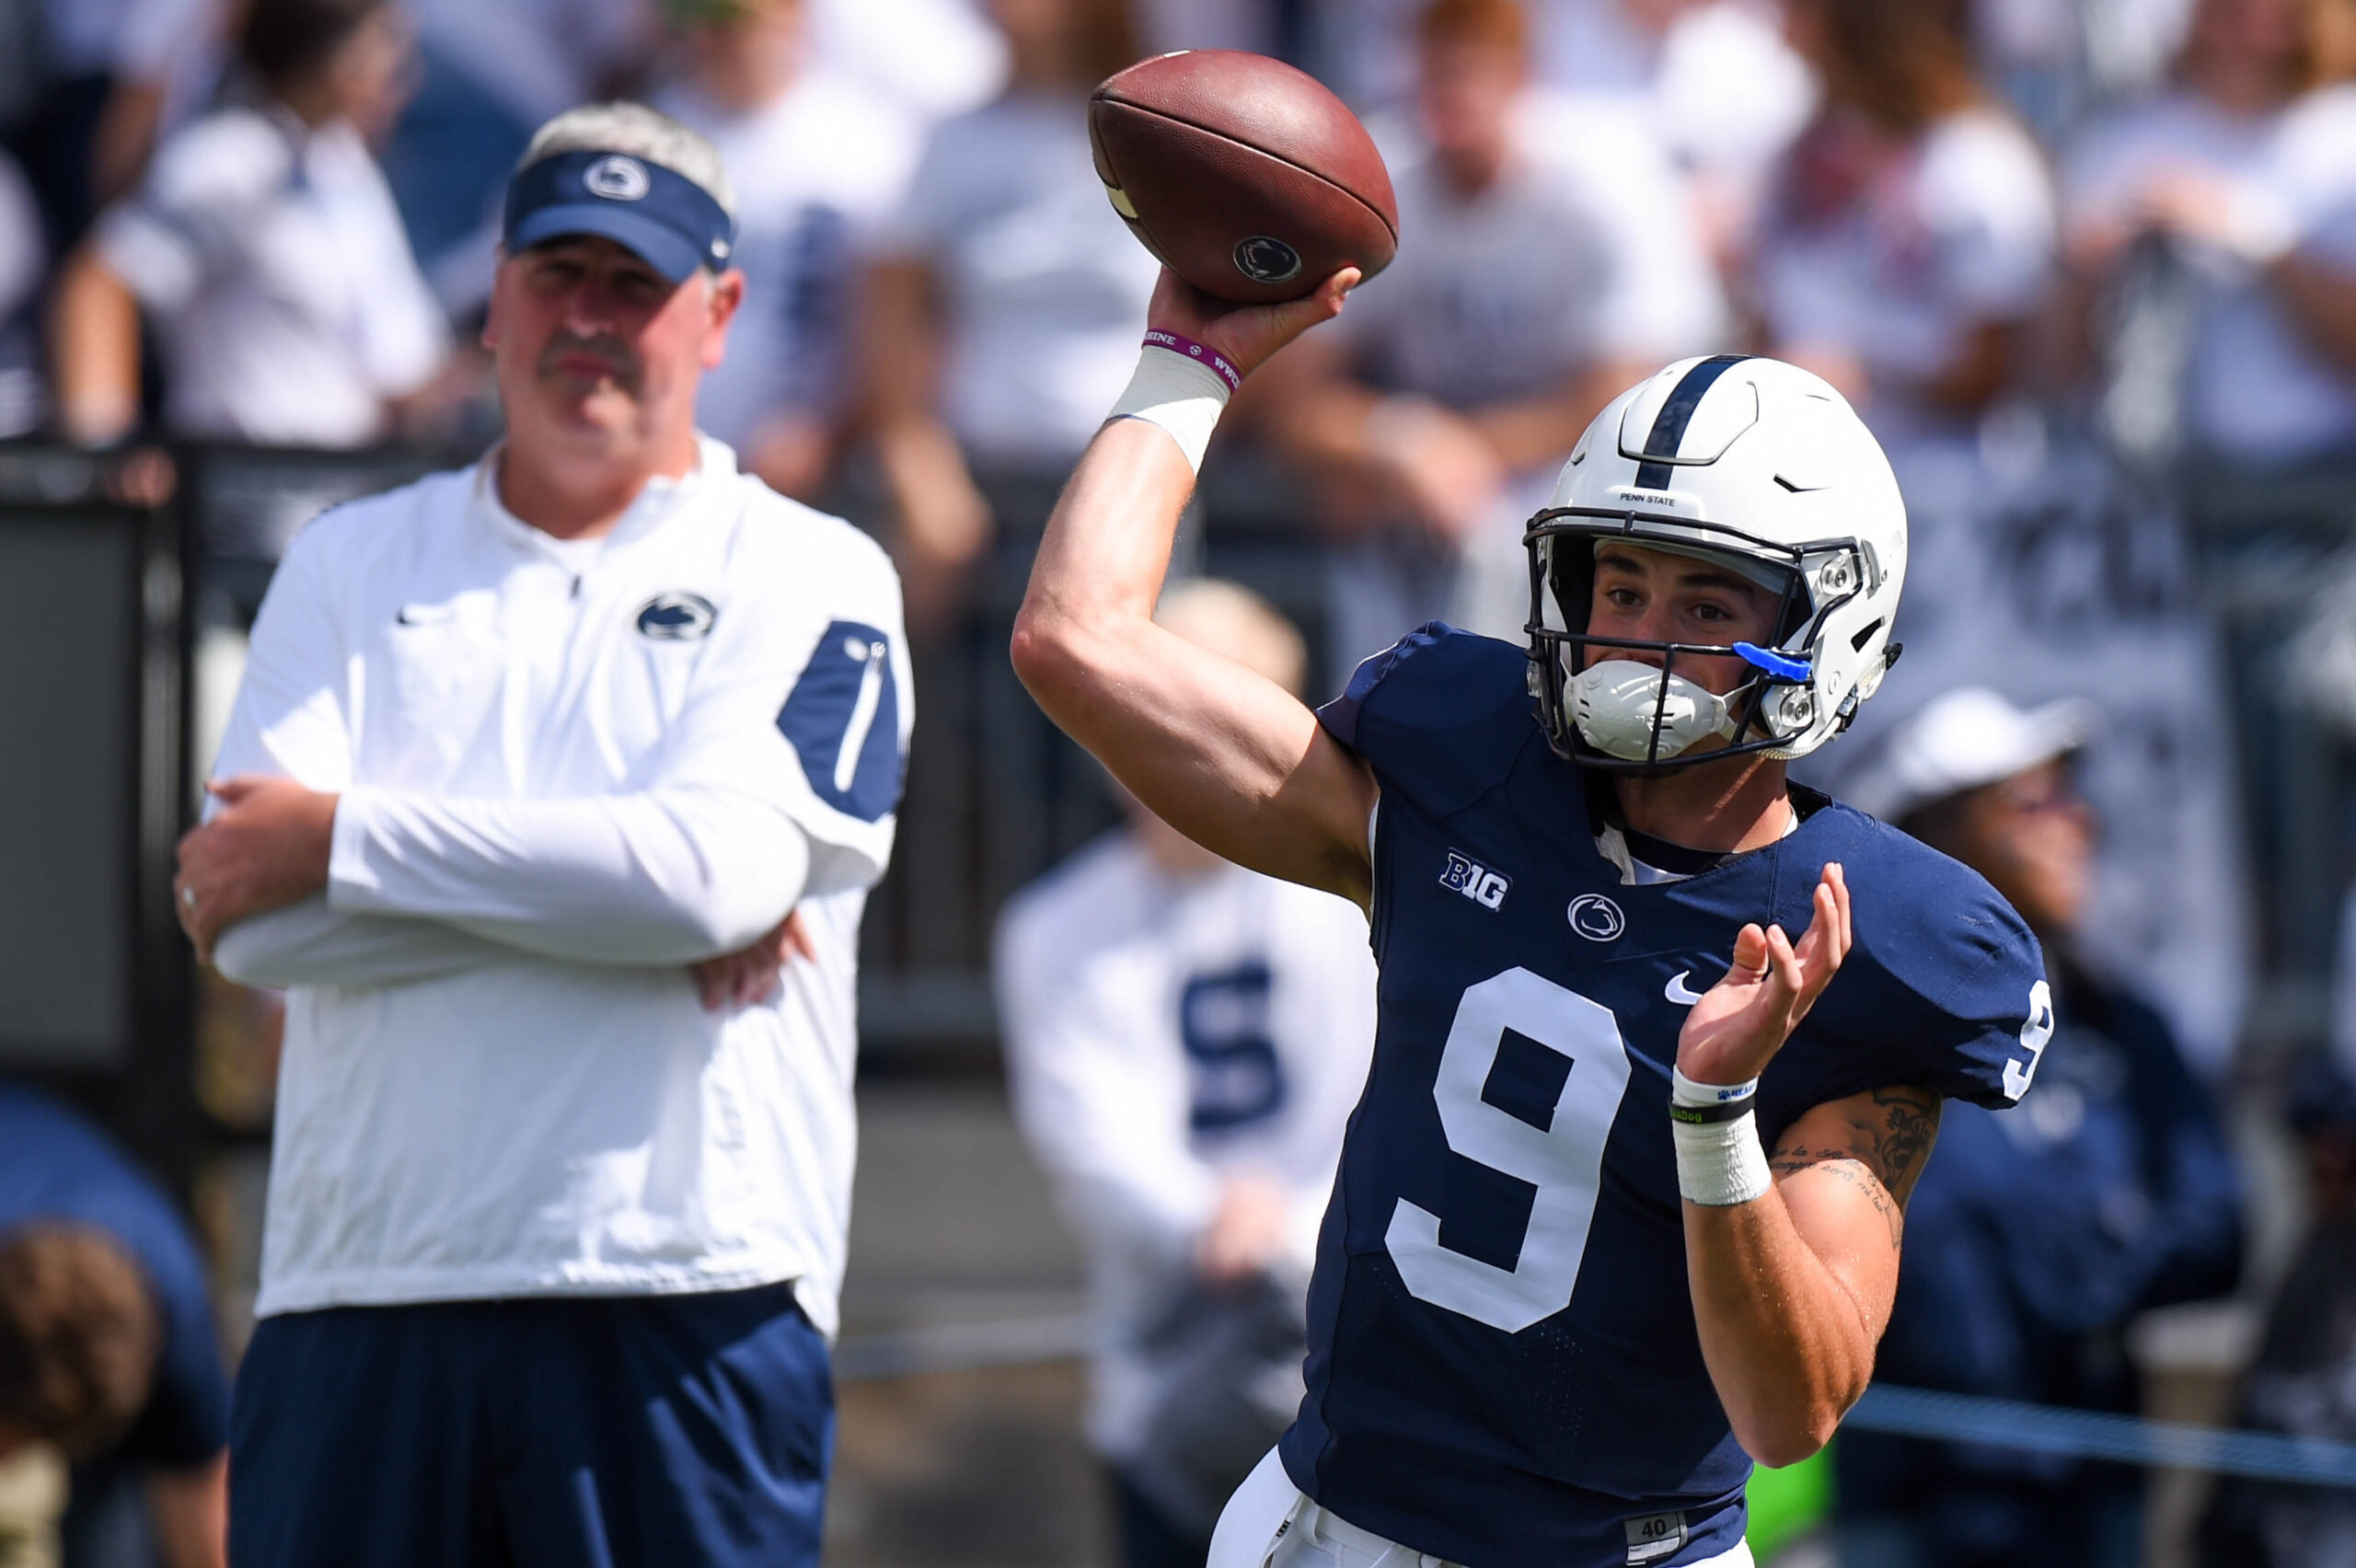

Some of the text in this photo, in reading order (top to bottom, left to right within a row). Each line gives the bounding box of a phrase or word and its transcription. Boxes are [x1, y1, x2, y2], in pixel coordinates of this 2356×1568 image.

[1620, 492, 1676, 507] PENN STATE
[1181, 959, 1287, 1134] S
[2002, 979, 2054, 1101] 9
[1384, 965, 1632, 1334] 9
[1642, 1519, 1667, 1538] 40
